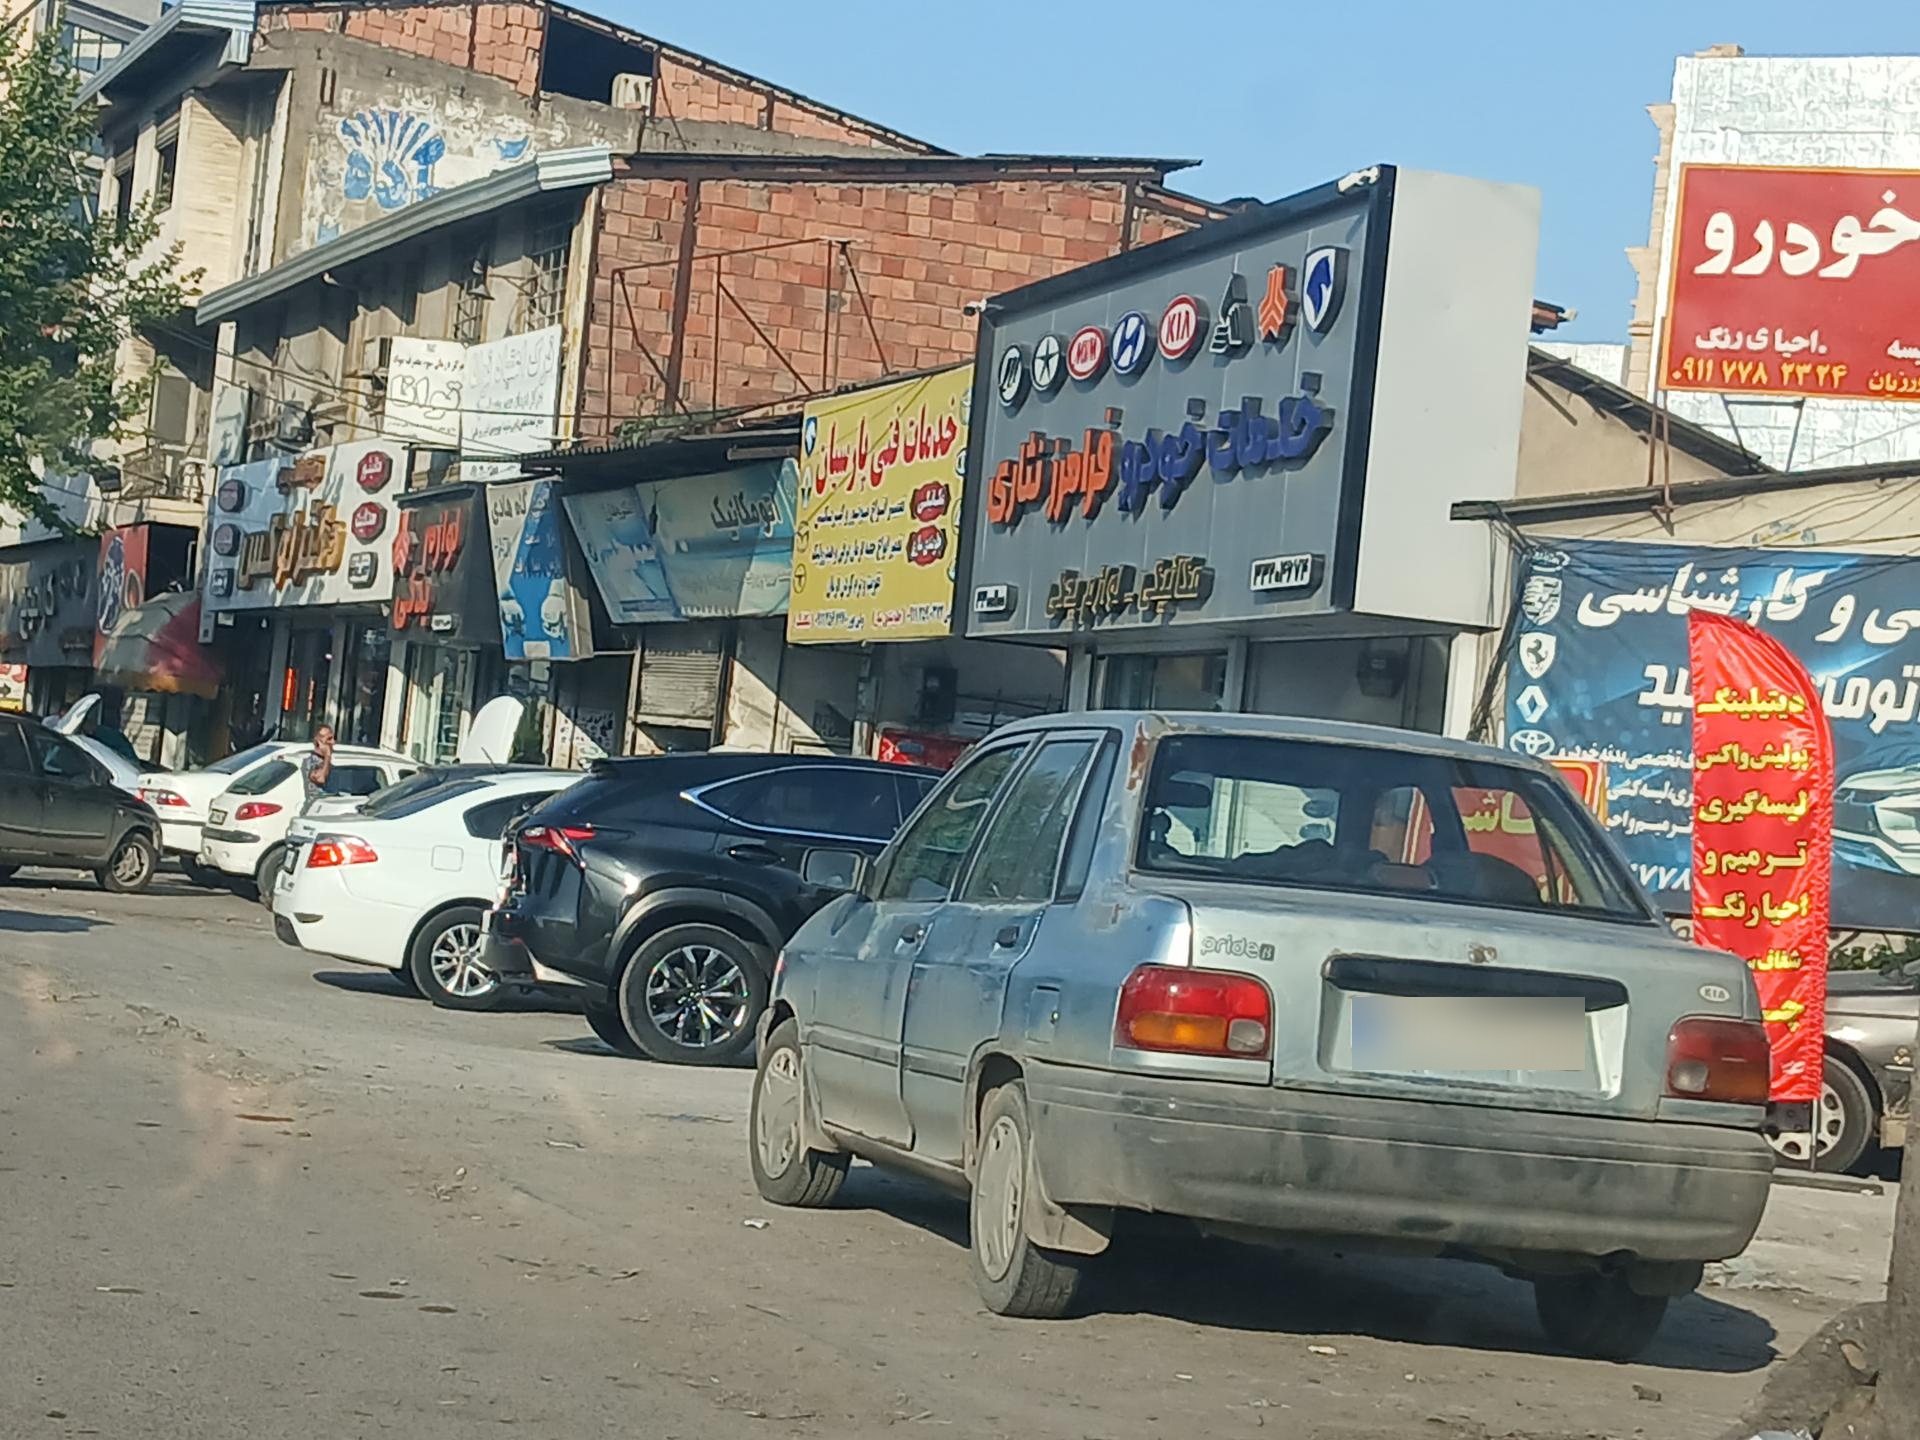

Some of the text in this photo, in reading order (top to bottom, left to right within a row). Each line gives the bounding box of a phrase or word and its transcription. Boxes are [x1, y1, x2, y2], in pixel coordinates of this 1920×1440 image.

[1694, 188, 1920, 279] خودرو
[1166, 310, 1191, 344] KIA
[1694, 326, 1744, 350] رنگ
[870, 404, 900, 488] فنی
[902, 397, 957, 464] خدمات
[1119, 399, 1208, 511] خودرو
[1208, 373, 1324, 472] خدمات
[1046, 406, 1122, 521] فرامرز
[421, 508, 462, 575] لوازم
[711, 490, 784, 541] اتومکانیک
[1721, 841, 1809, 878] ترمیم
[1200, 933, 1259, 959] pride
